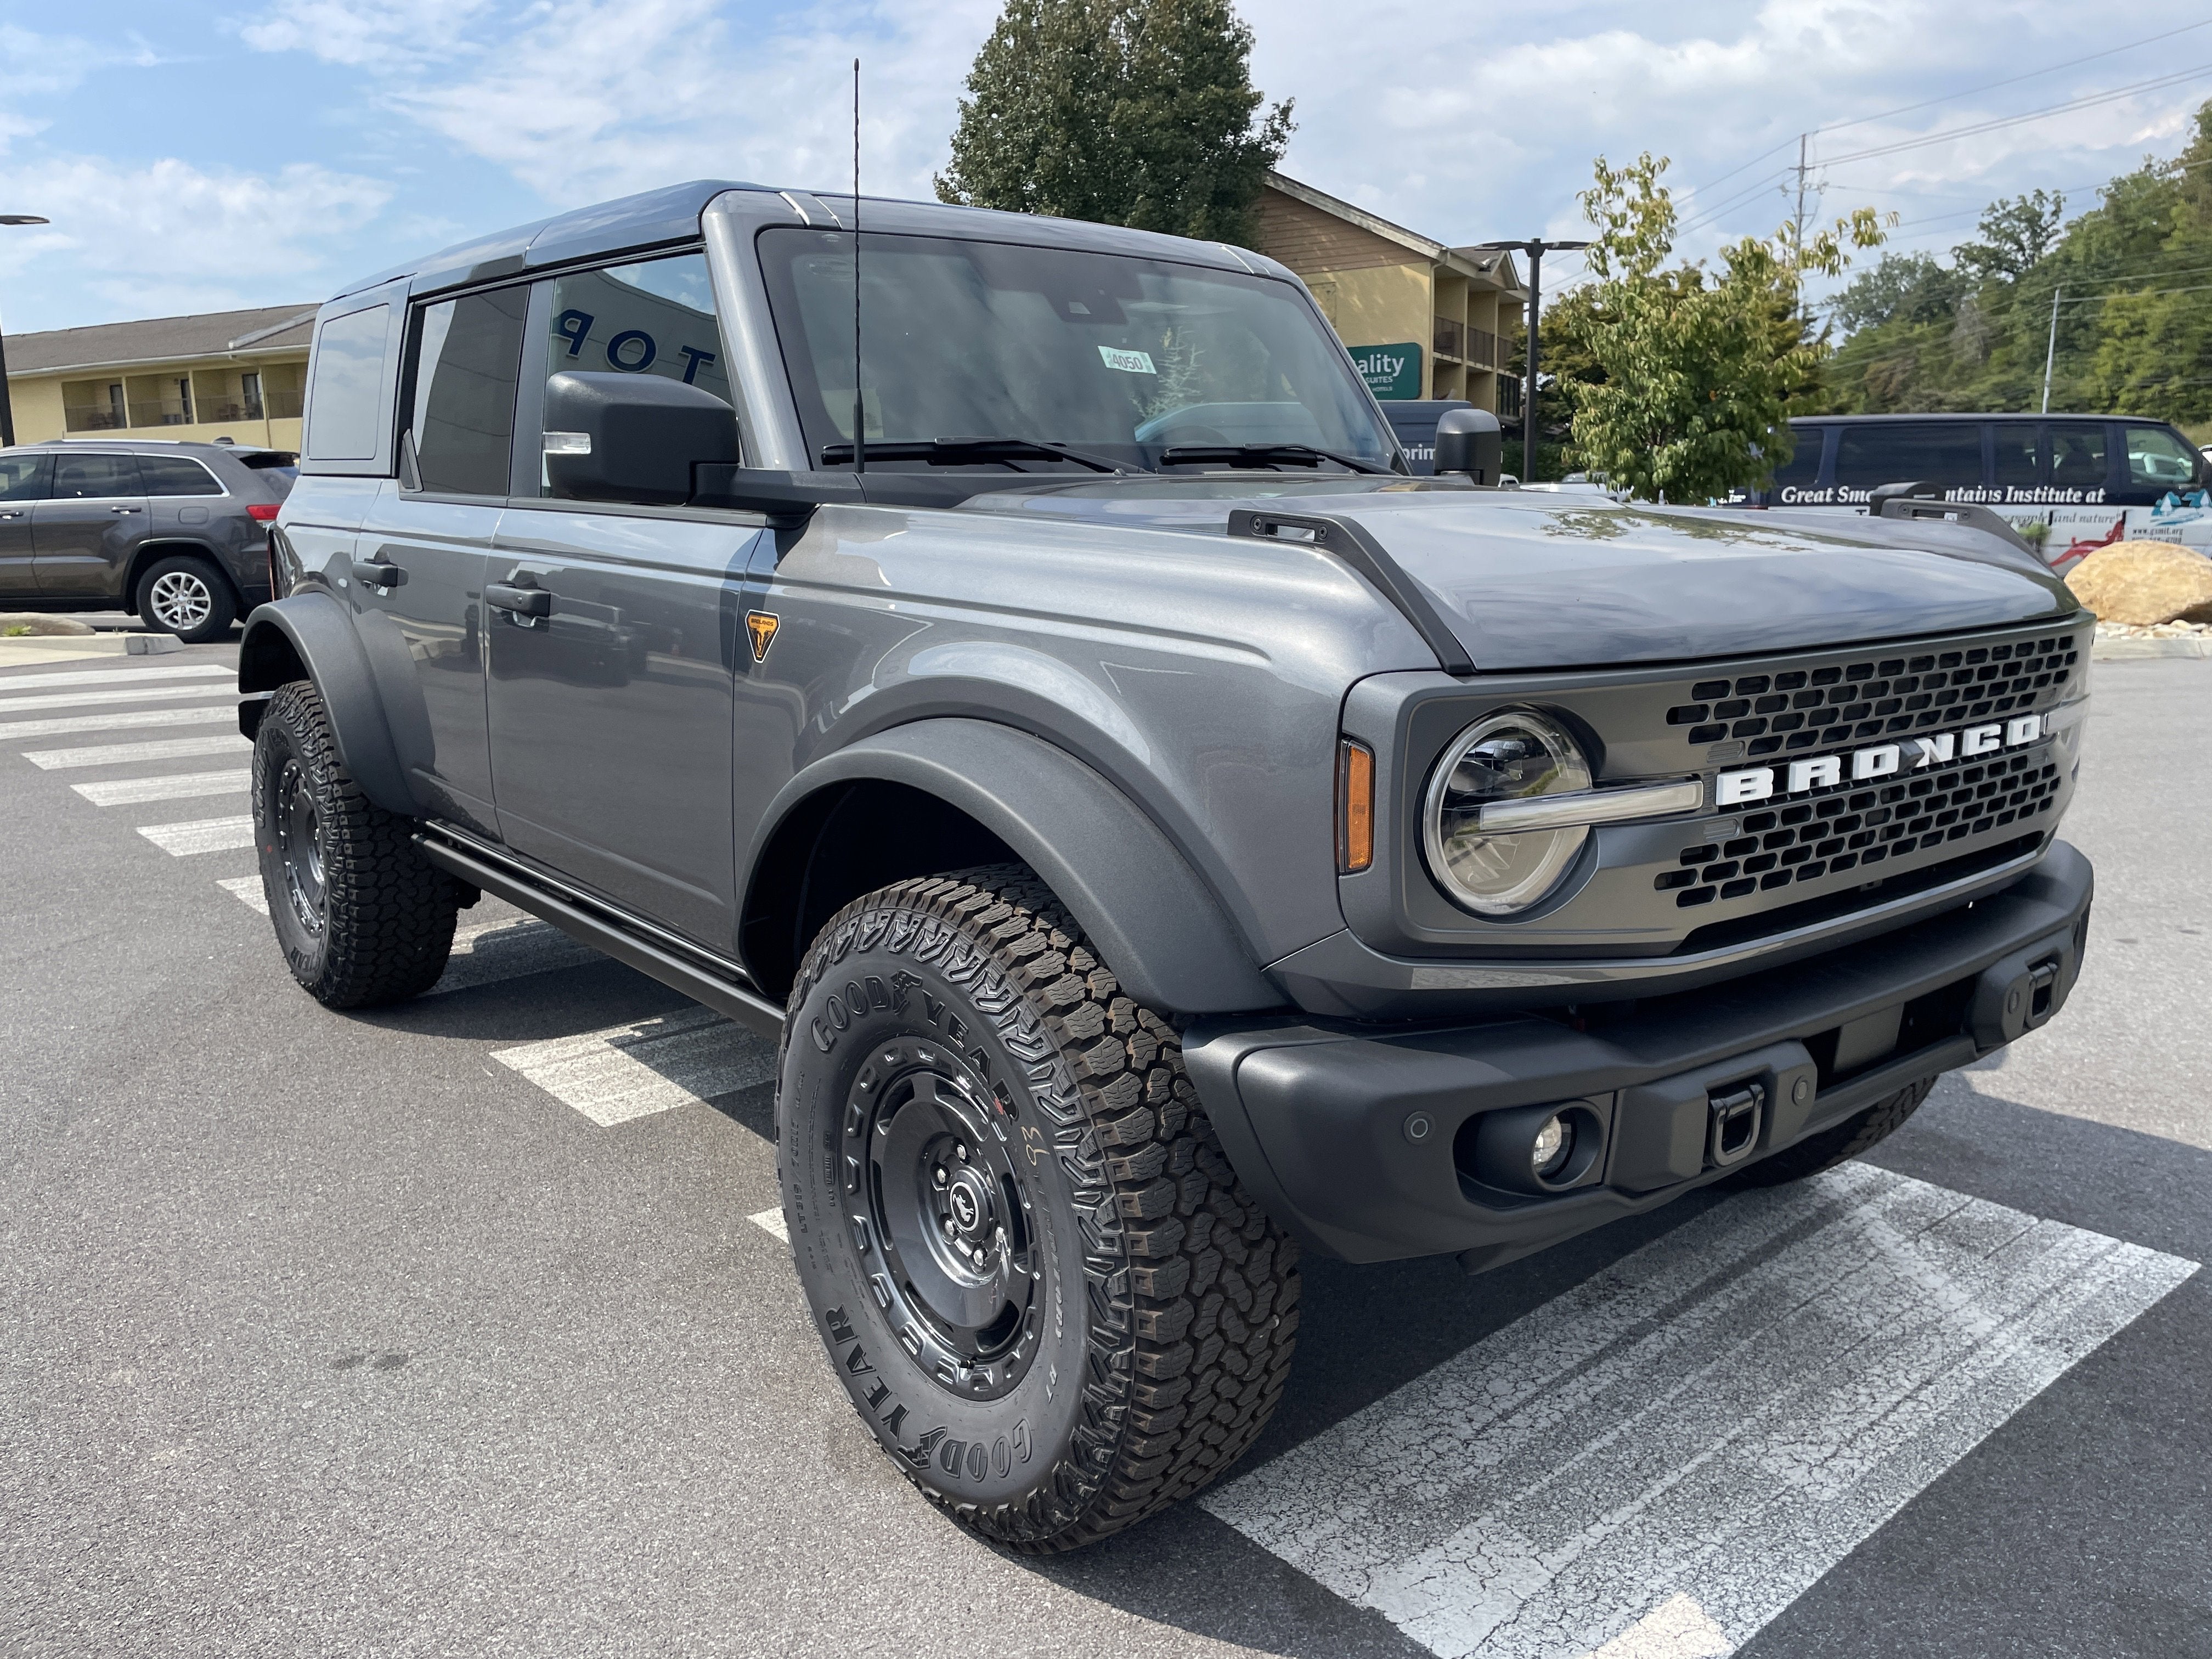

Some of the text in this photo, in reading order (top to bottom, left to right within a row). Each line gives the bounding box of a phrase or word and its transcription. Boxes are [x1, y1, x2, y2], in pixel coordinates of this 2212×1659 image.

[1112, 354, 1144, 370] 4050
[1354, 353, 1404, 377] ality
[1781, 486, 1834, 504] Great
[1945, 486, 2002, 503] ntains
[2004, 485, 2083, 504] Institute
[2086, 487, 2106, 504] at
[751, 618, 774, 627] BADLANDS
[1716, 714, 2043, 806] BRONCO
